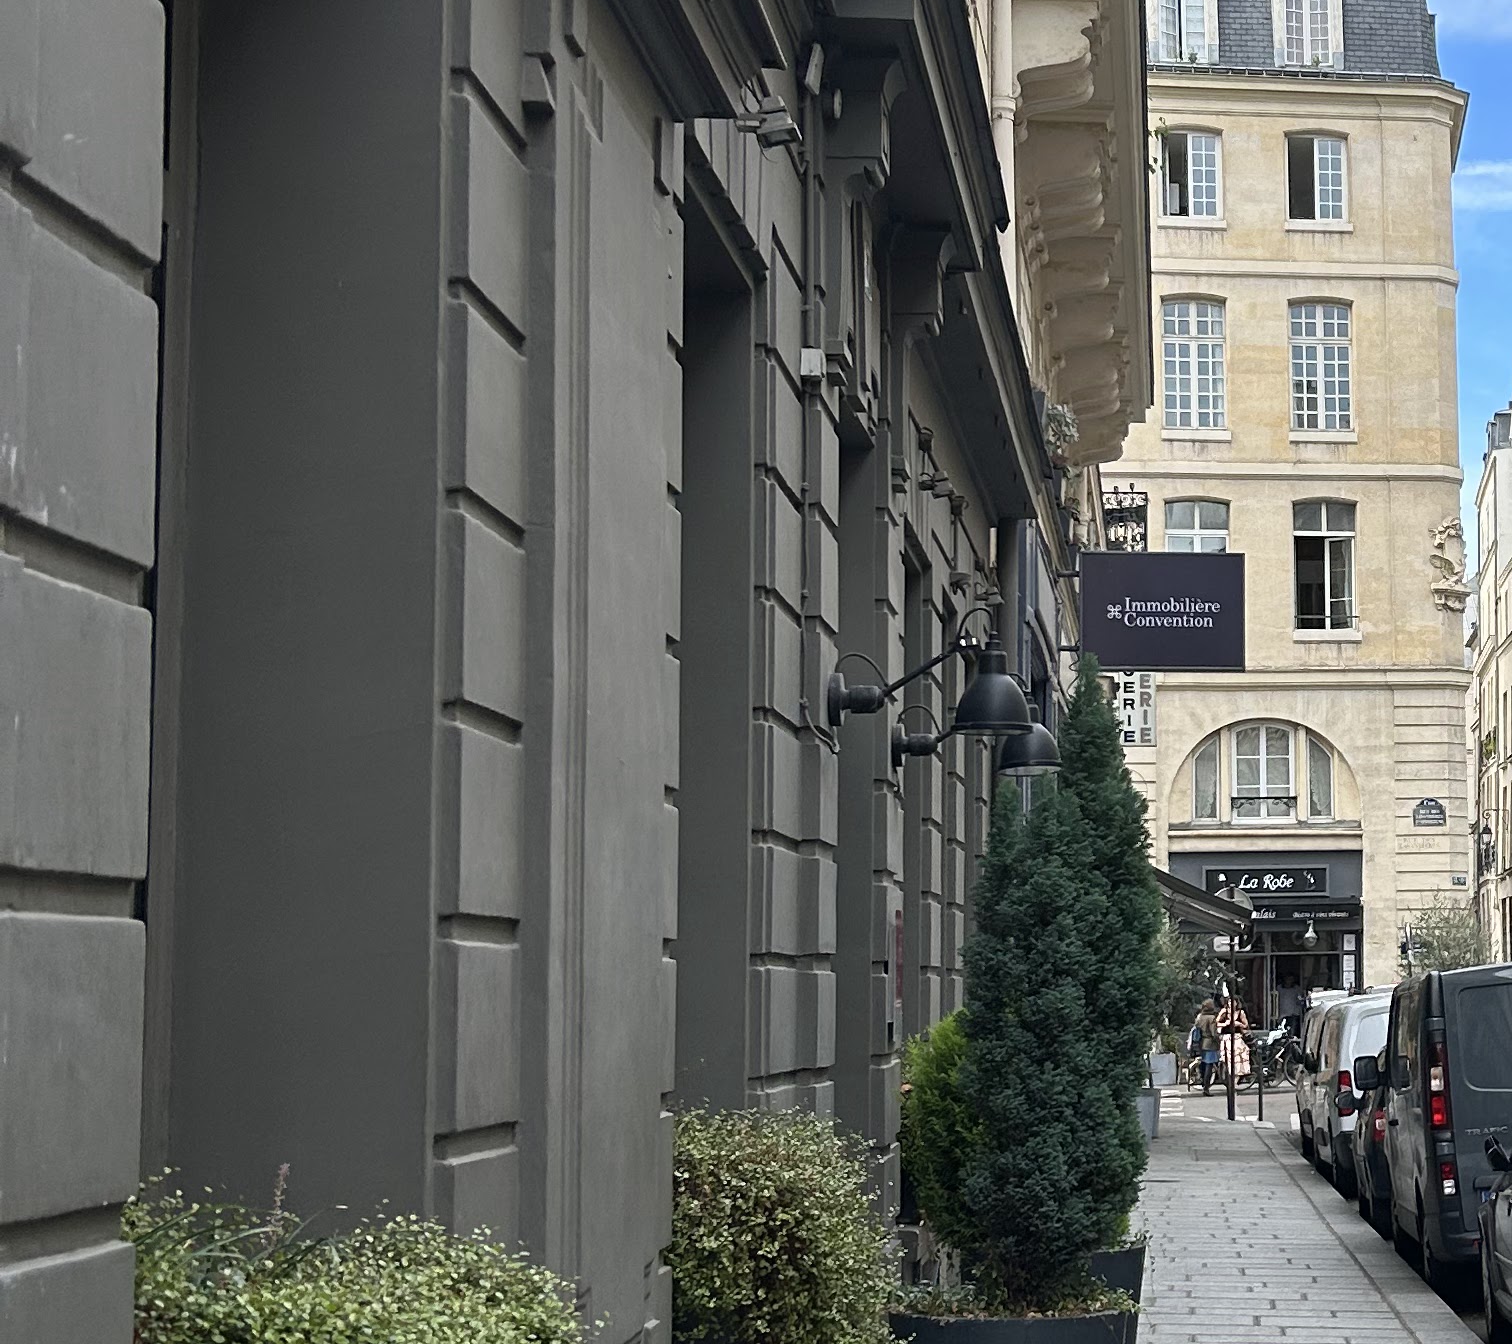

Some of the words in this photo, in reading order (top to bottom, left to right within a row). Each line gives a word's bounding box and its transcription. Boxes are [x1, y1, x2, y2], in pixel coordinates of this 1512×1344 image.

[1124, 596, 1221, 613] Immobilière
[1124, 612, 1213, 628] Convention
[1123, 672, 1136, 743] ERIE
[1238, 874, 1259, 889] La
[1263, 873, 1295, 890] Robe
[1465, 1126, 1508, 1136] TRAFIC
